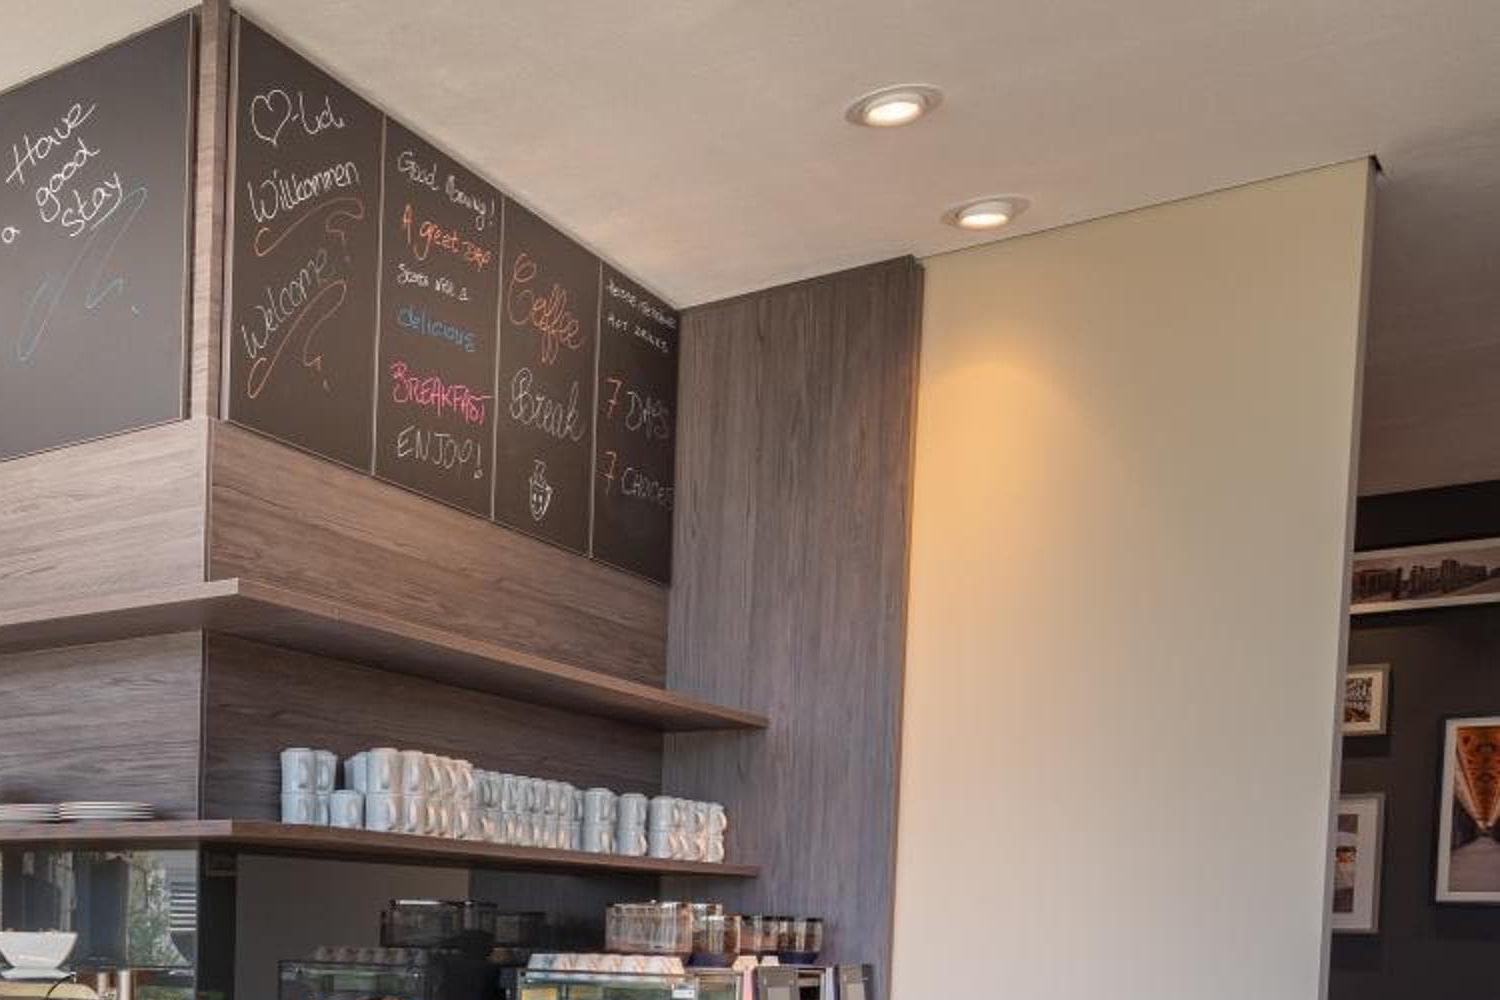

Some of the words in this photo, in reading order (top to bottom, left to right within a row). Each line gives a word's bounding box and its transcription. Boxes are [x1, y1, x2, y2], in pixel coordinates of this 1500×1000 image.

[5, 103, 96, 184] Have
[1, 226, 21, 244] a
[35, 136, 101, 223] good
[247, 161, 360, 224] Willkommen
